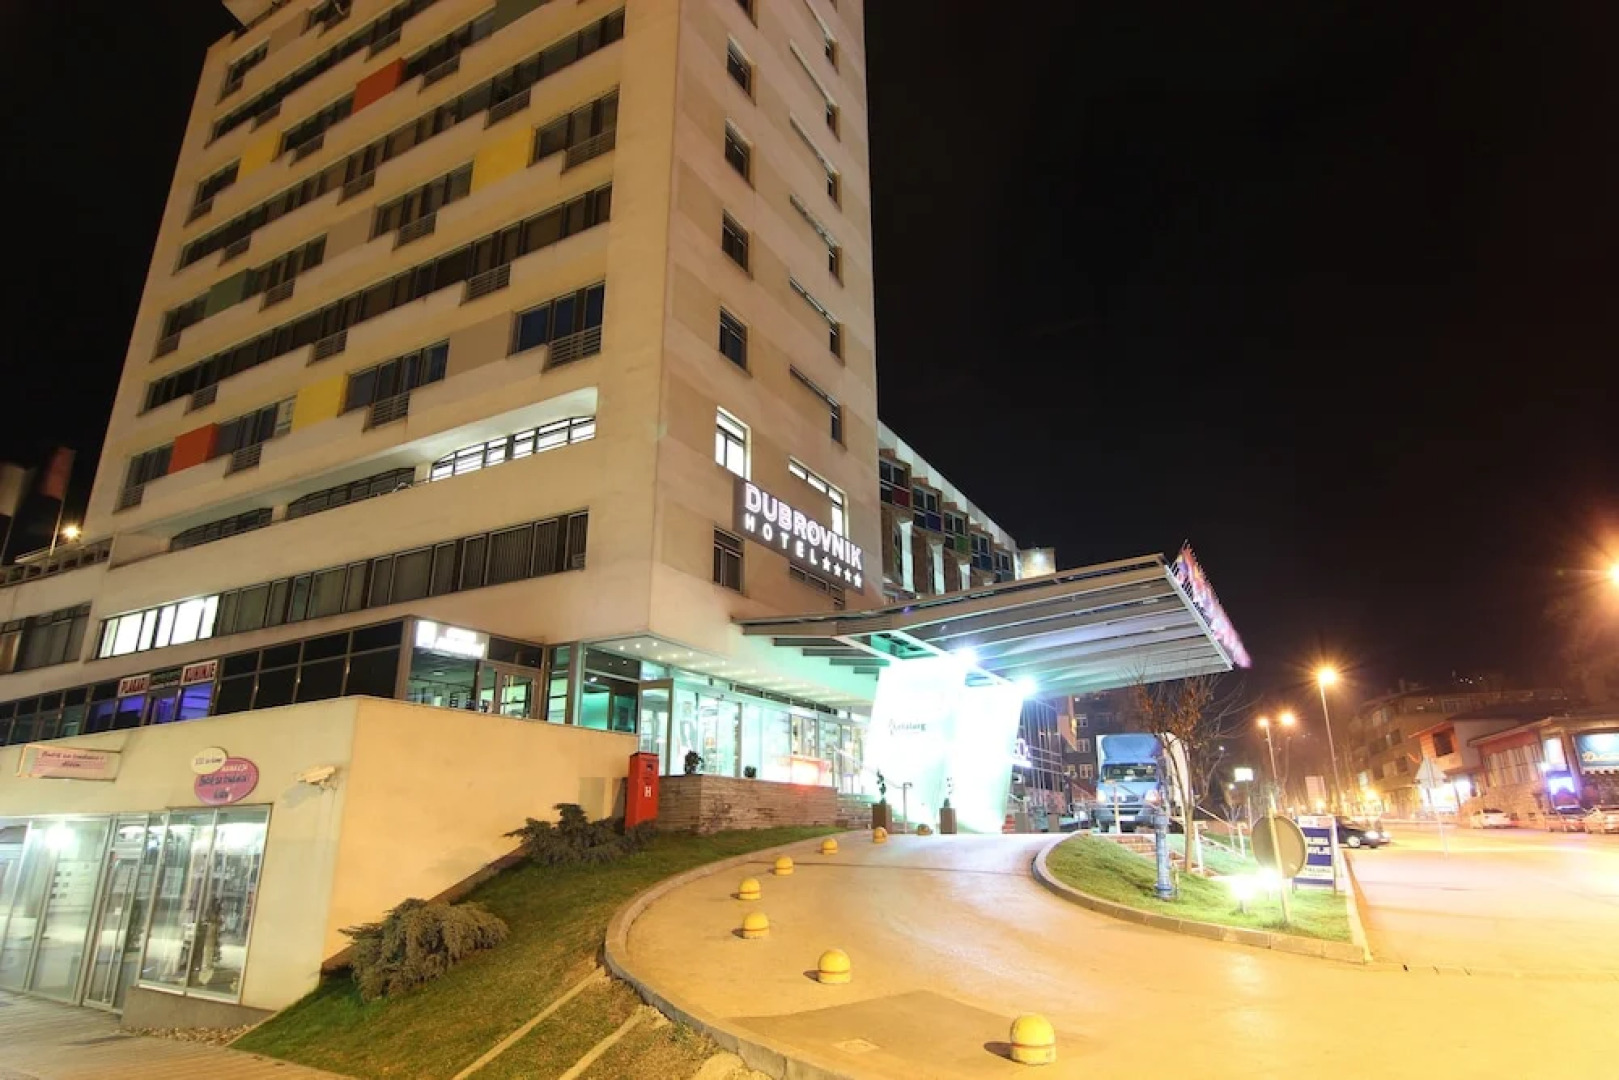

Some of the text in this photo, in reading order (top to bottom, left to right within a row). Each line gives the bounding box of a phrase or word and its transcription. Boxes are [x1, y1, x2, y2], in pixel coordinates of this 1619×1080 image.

[744, 512, 818, 565] HOTEL
[745, 482, 863, 570] DUBROVNIK
[644, 786, 652, 797] H
